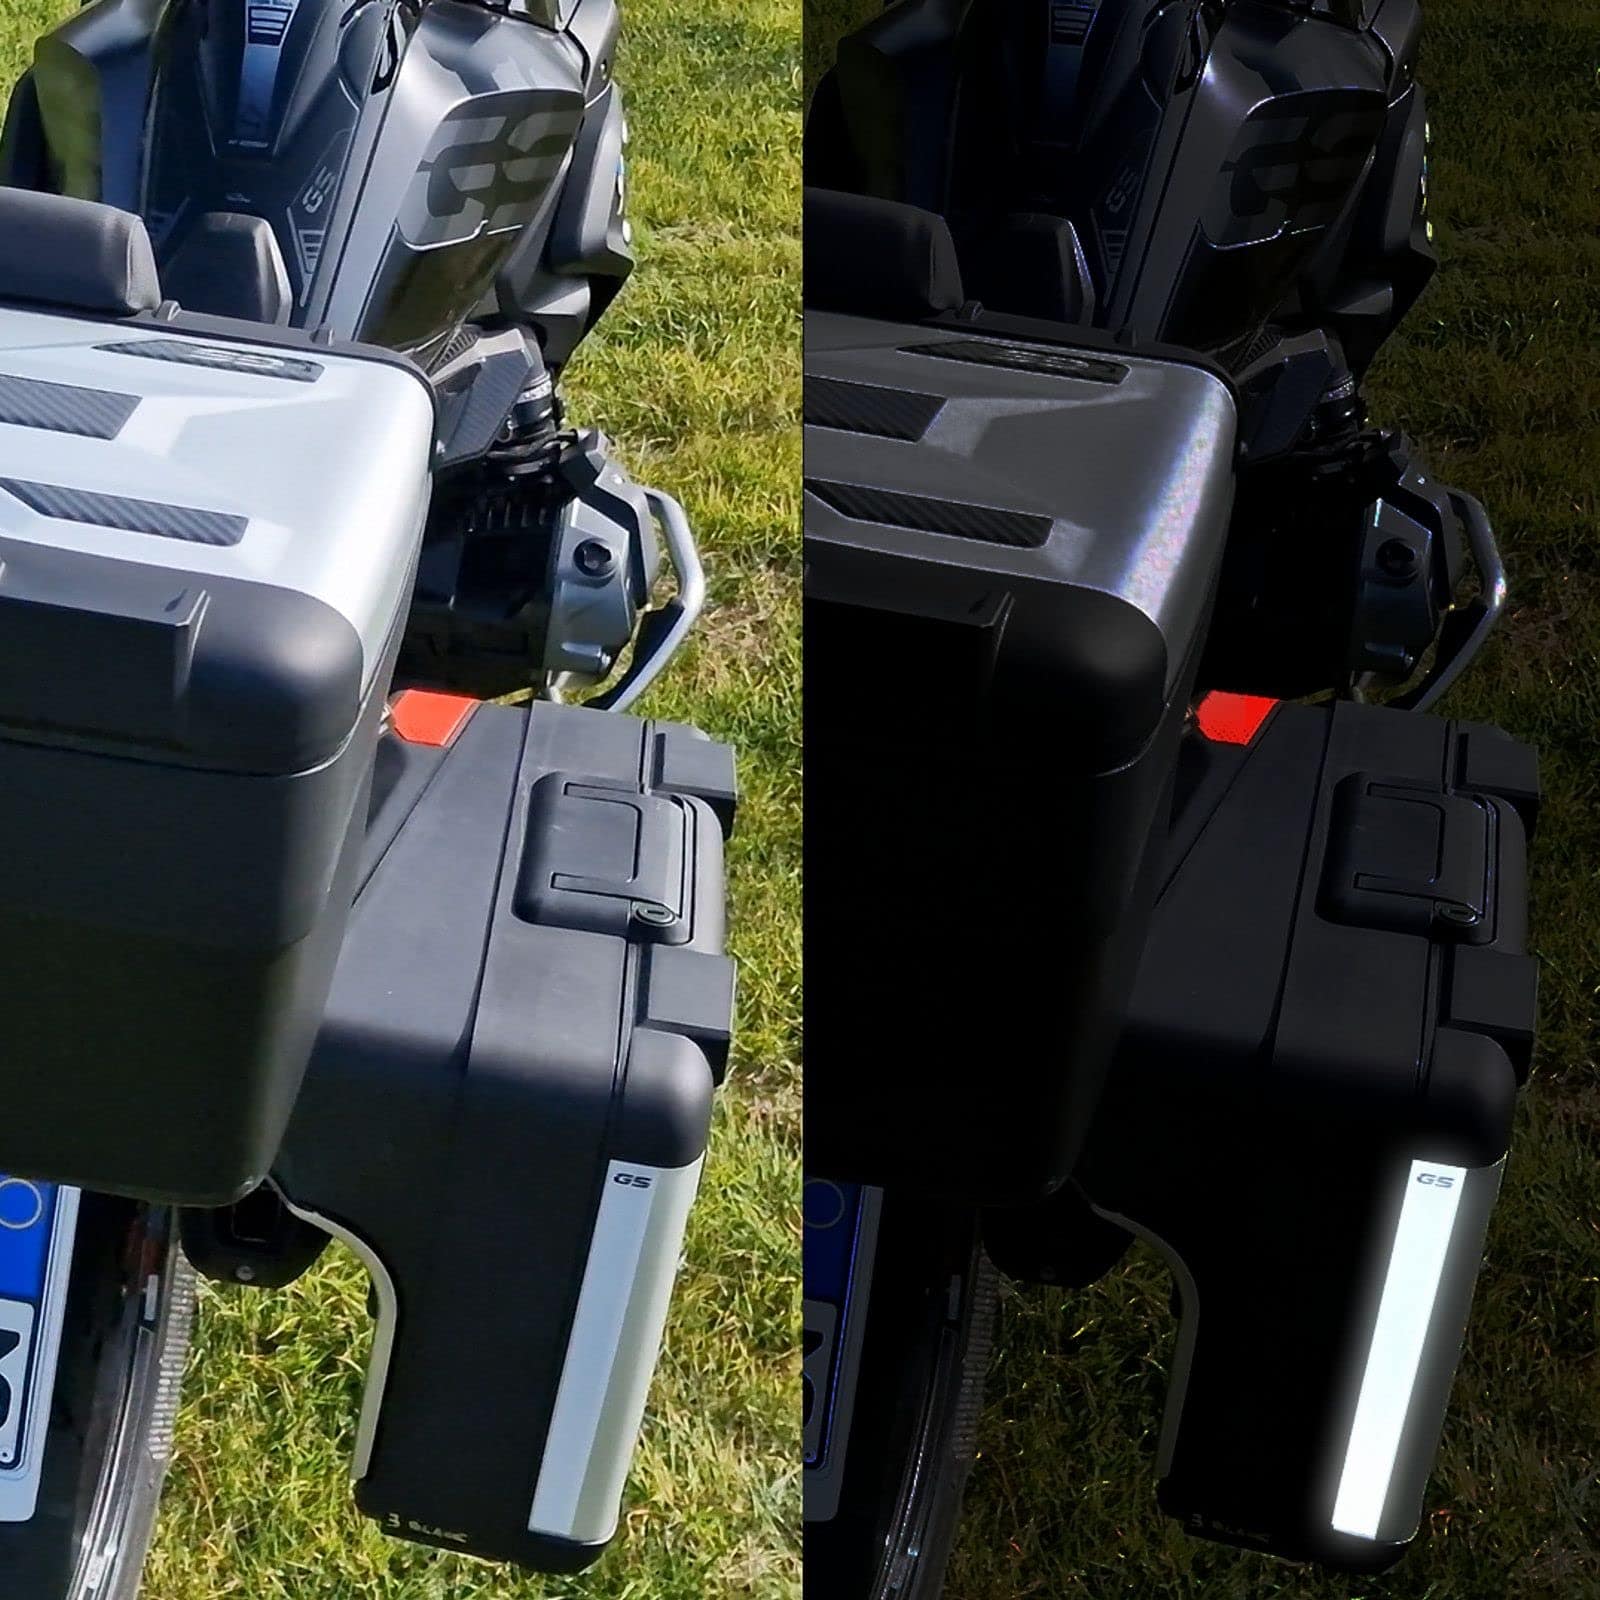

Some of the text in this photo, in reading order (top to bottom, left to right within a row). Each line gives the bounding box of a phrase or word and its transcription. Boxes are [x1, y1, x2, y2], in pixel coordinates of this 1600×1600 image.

[302, 165, 337, 214] GS
[613, 1172, 652, 1189] GS
[1416, 1172, 1456, 1189] GS
